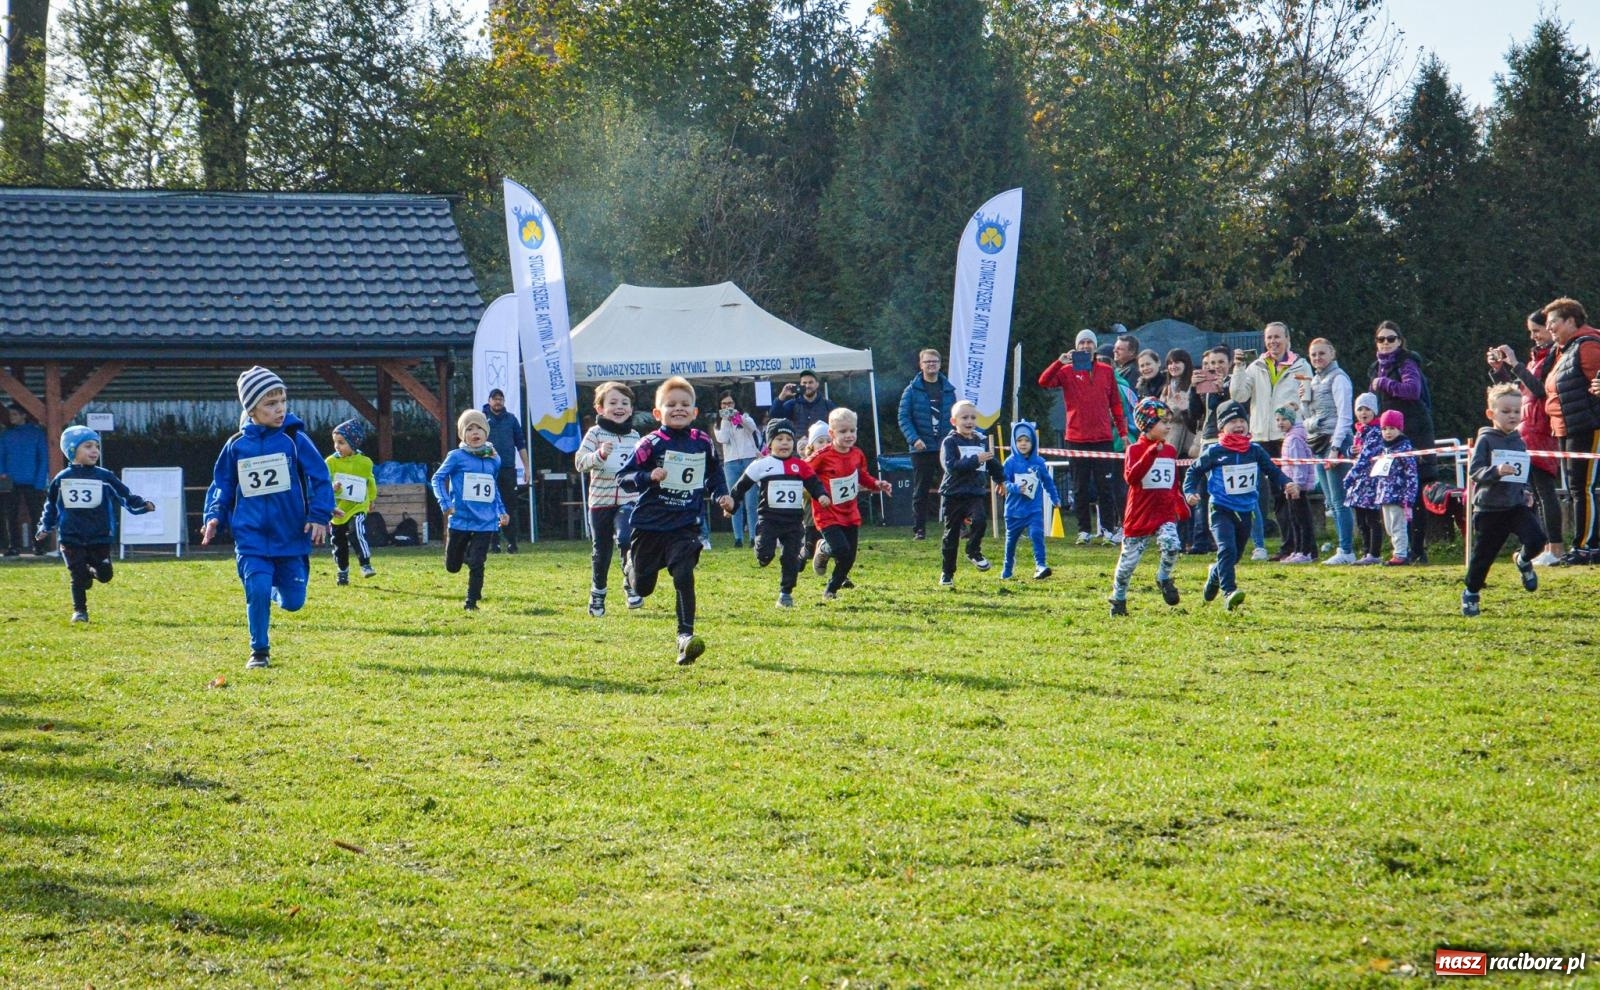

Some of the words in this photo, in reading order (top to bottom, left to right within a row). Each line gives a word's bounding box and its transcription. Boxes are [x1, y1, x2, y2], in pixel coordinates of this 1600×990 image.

[529, 254, 550, 311] STOWARZYSZENIE
[975, 258, 997, 312] STOWARZYSZENIE
[536, 313, 555, 342] AKTYWNI
[971, 313, 990, 342] AKTYWNI
[542, 342, 559, 357] DLA
[969, 342, 987, 355] DLA
[545, 356, 565, 391] LEPSZEGO
[587, 362, 662, 377] STOWARZYSZENIE
[670, 361, 708, 374] AKTYWNI
[715, 360, 732, 373] DLA
[739, 358, 782, 372] LEPSZEGO
[789, 357, 816, 370] JUTRA
[966, 354, 984, 390] LEPSZEGO
[552, 391, 569, 414] JUTRA
[248, 469, 279, 489] 32
[682, 467, 694, 484] 6
[1151, 469, 1171, 483] 35
[1226, 473, 1255, 489] 121
[69, 489, 92, 502] 33
[346, 484, 354, 496] 1
[473, 483, 491, 497] 19
[776, 490, 797, 503] 29
[839, 482, 856, 498] 21
